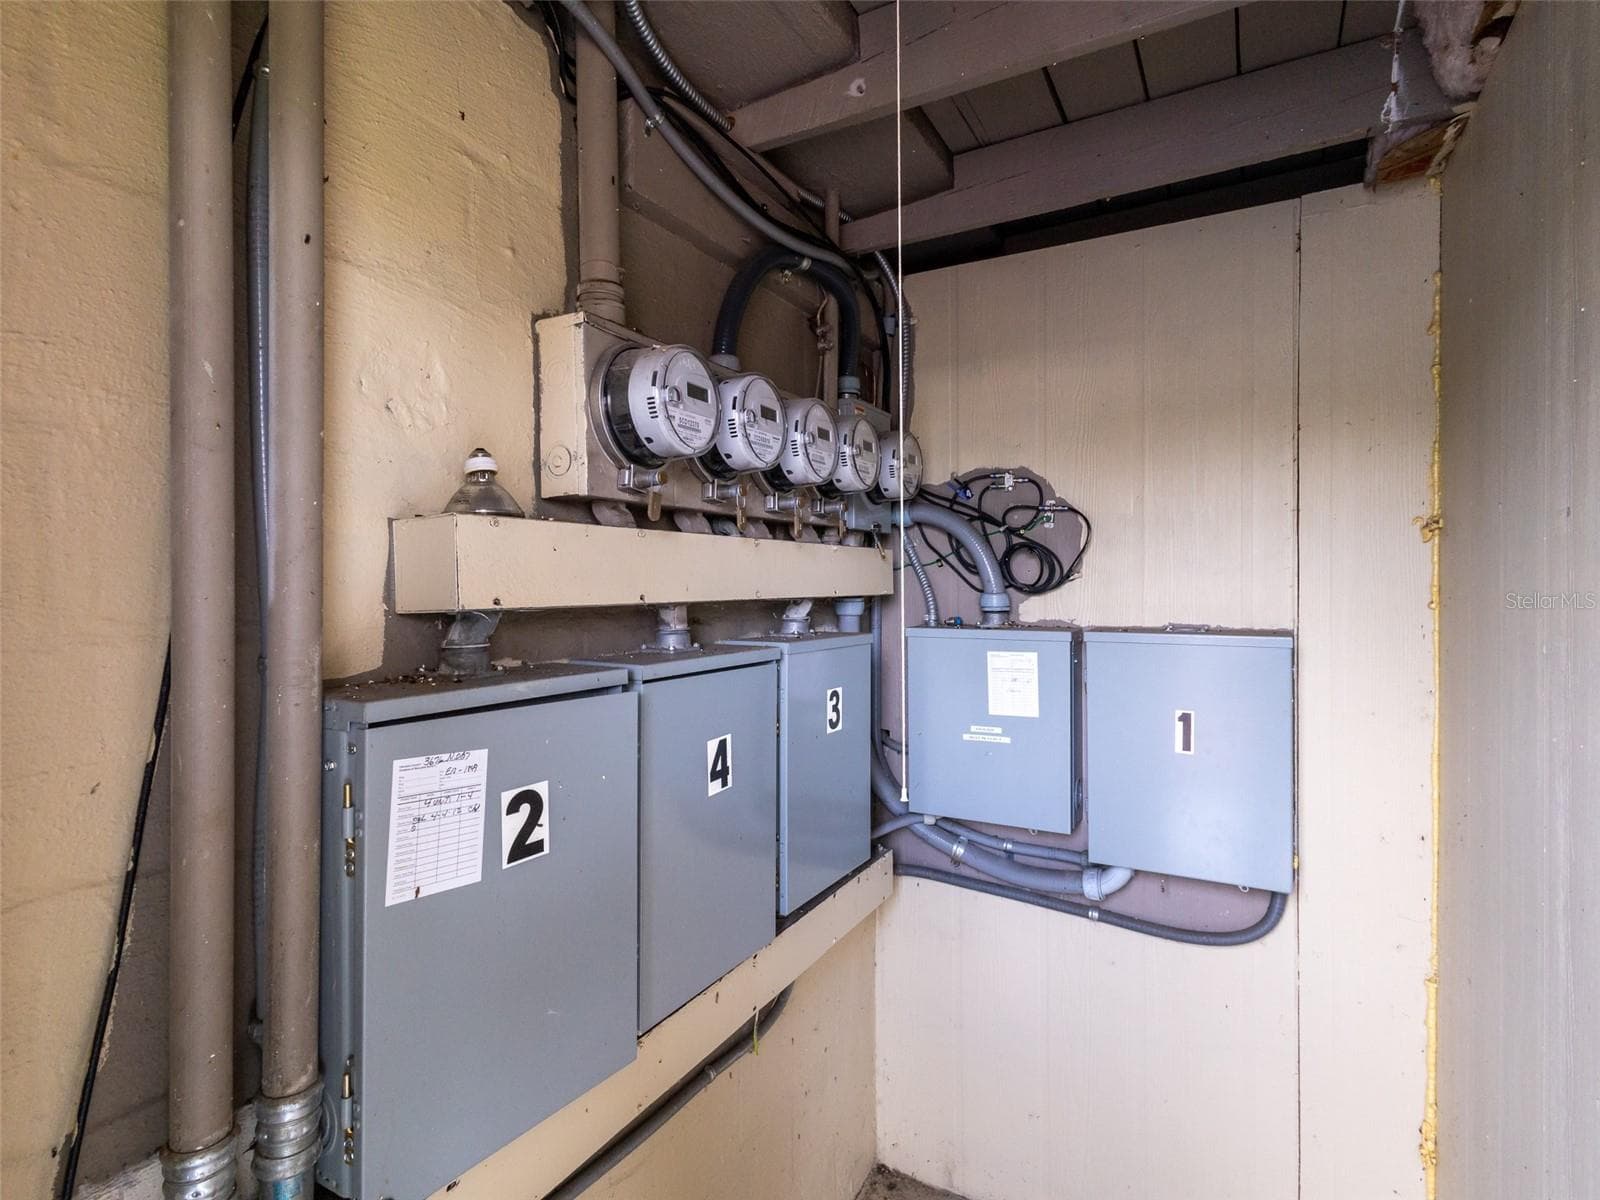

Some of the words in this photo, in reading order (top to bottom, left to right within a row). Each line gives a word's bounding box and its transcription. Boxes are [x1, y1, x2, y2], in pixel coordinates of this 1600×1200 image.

[828, 689, 841, 730] 3
[1177, 711, 1192, 752] 1
[709, 737, 730, 789] 4
[505, 788, 545, 865] 2
